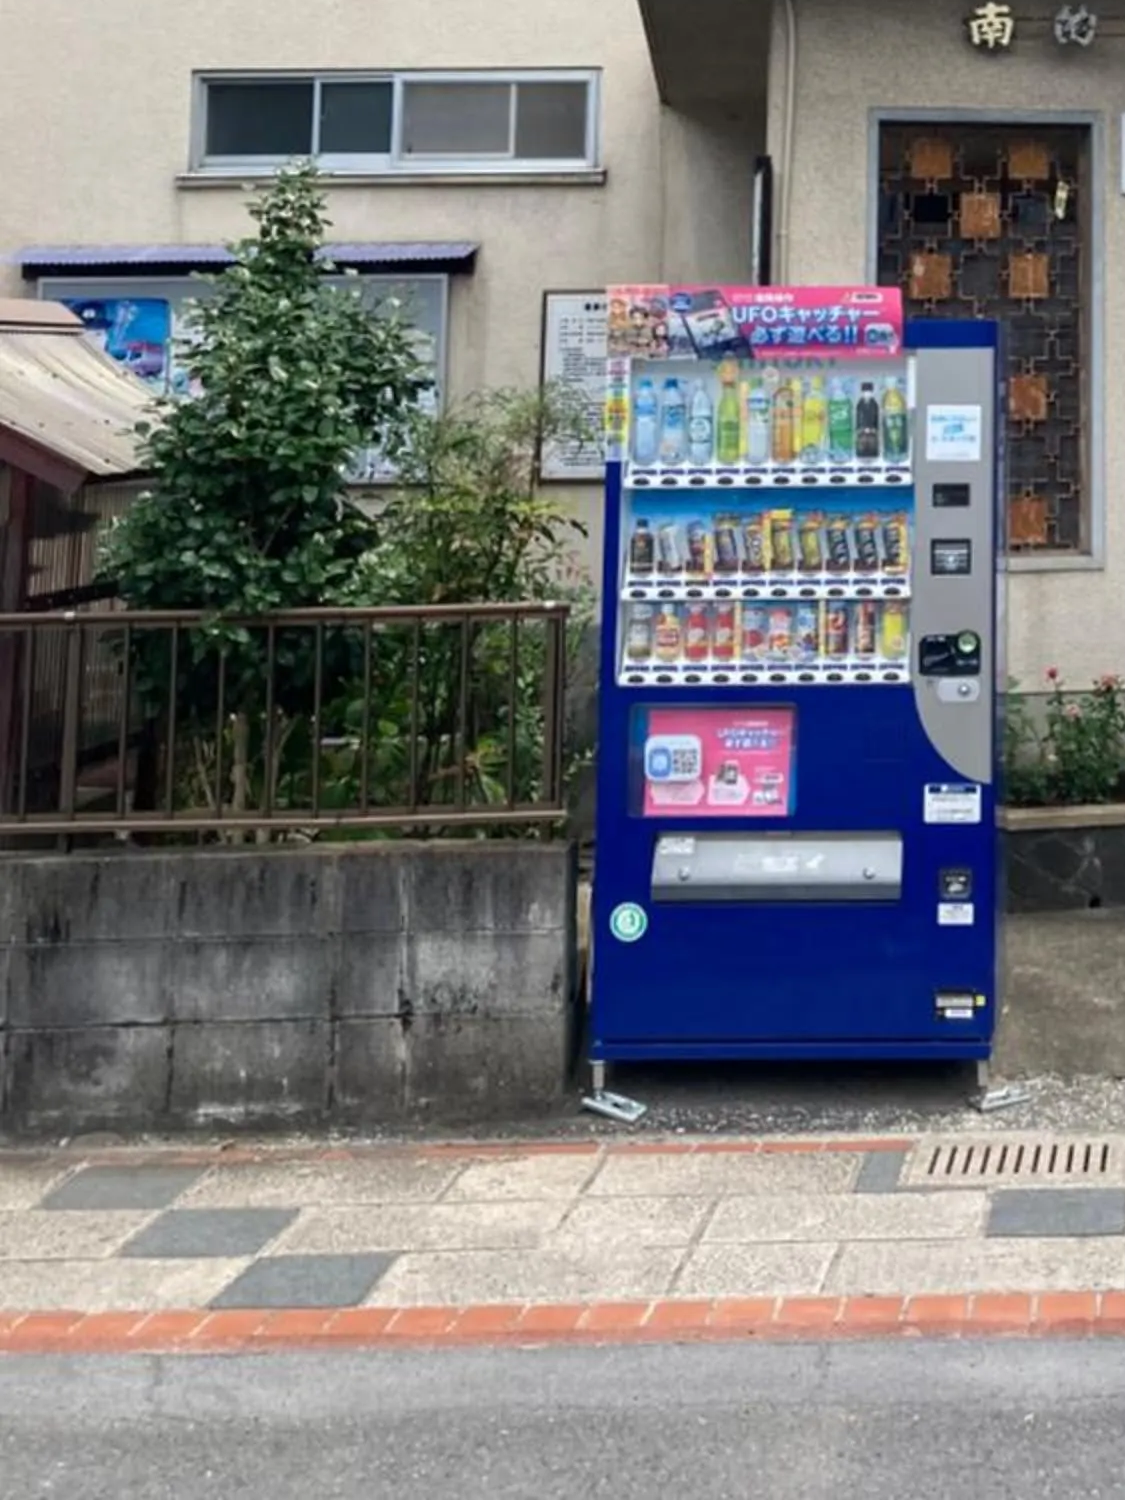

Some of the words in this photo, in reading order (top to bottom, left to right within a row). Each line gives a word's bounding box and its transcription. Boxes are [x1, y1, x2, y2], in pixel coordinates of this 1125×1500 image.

[732, 305, 880, 323] UFOキャッチャー
